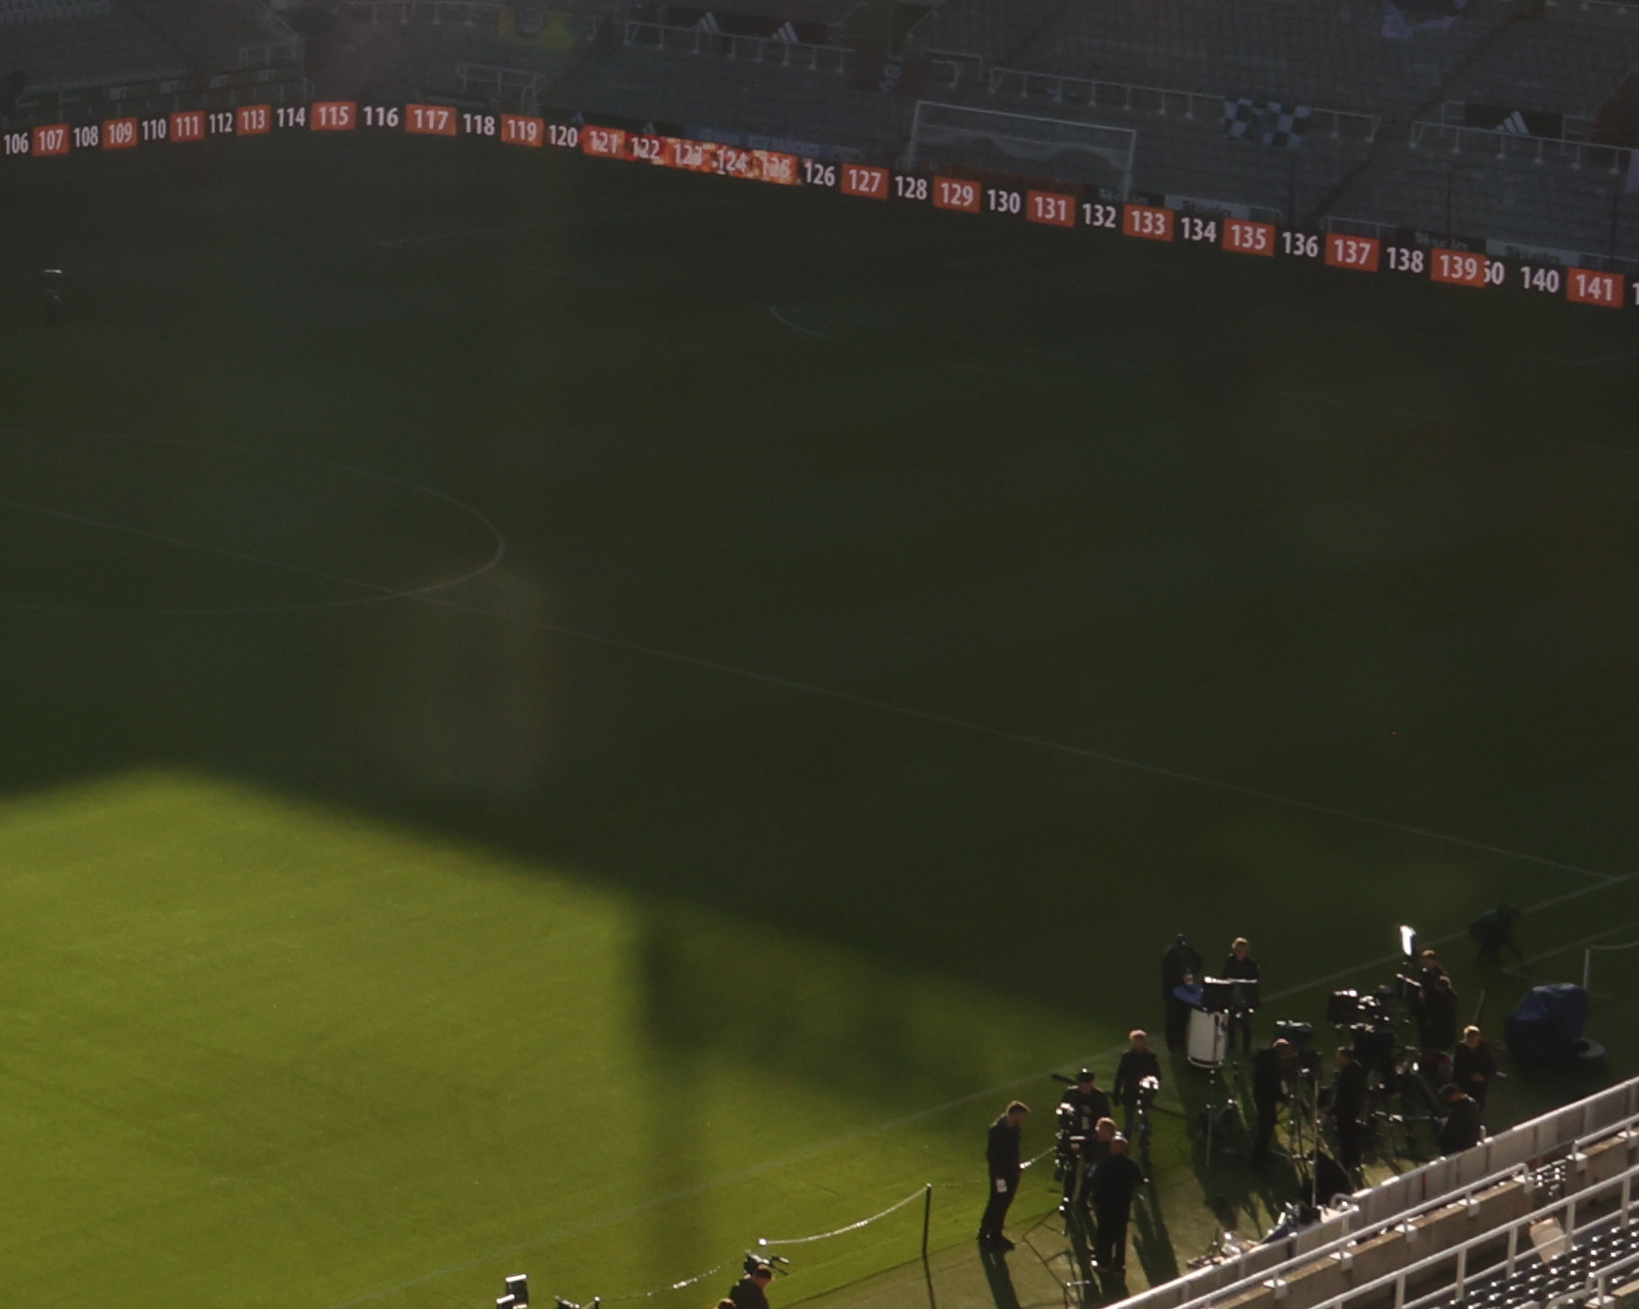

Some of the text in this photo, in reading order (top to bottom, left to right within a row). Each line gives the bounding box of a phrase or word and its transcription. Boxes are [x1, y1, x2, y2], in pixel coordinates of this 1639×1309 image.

[4, 133, 28, 154] 106
[39, 129, 64, 150] 107
[74, 126, 98, 147] 108
[109, 122, 132, 143] 109
[143, 119, 166, 140] 110
[176, 116, 198, 136] 111
[210, 113, 232, 133] 112
[243, 109, 265, 130] 113
[277, 107, 305, 127] 114
[319, 106, 349, 125] 115
[364, 107, 398, 126] 116
[415, 109, 448, 129] 117
[464, 114, 494, 135] 118
[508, 120, 537, 141] 119
[549, 125, 577, 147] 120
[804, 160, 835, 186] 126
[849, 169, 881, 192] 127
[895, 176, 927, 199] 128
[942, 183, 973, 206] 129
[988, 190, 1020, 213] 130
[1035, 197, 1065, 220] 131
[1083, 204, 1115, 228] 132
[1132, 211, 1165, 234] 133
[1182, 218, 1216, 242] 134
[1232, 225, 1266, 249] 135
[1283, 232, 1318, 257] 136
[1335, 240, 1371, 264] 137
[1387, 247, 1423, 272] 138
[1440, 255, 1477, 280] 139
[1521, 267, 1559, 292] 140
[1577, 274, 1612, 301] 141
